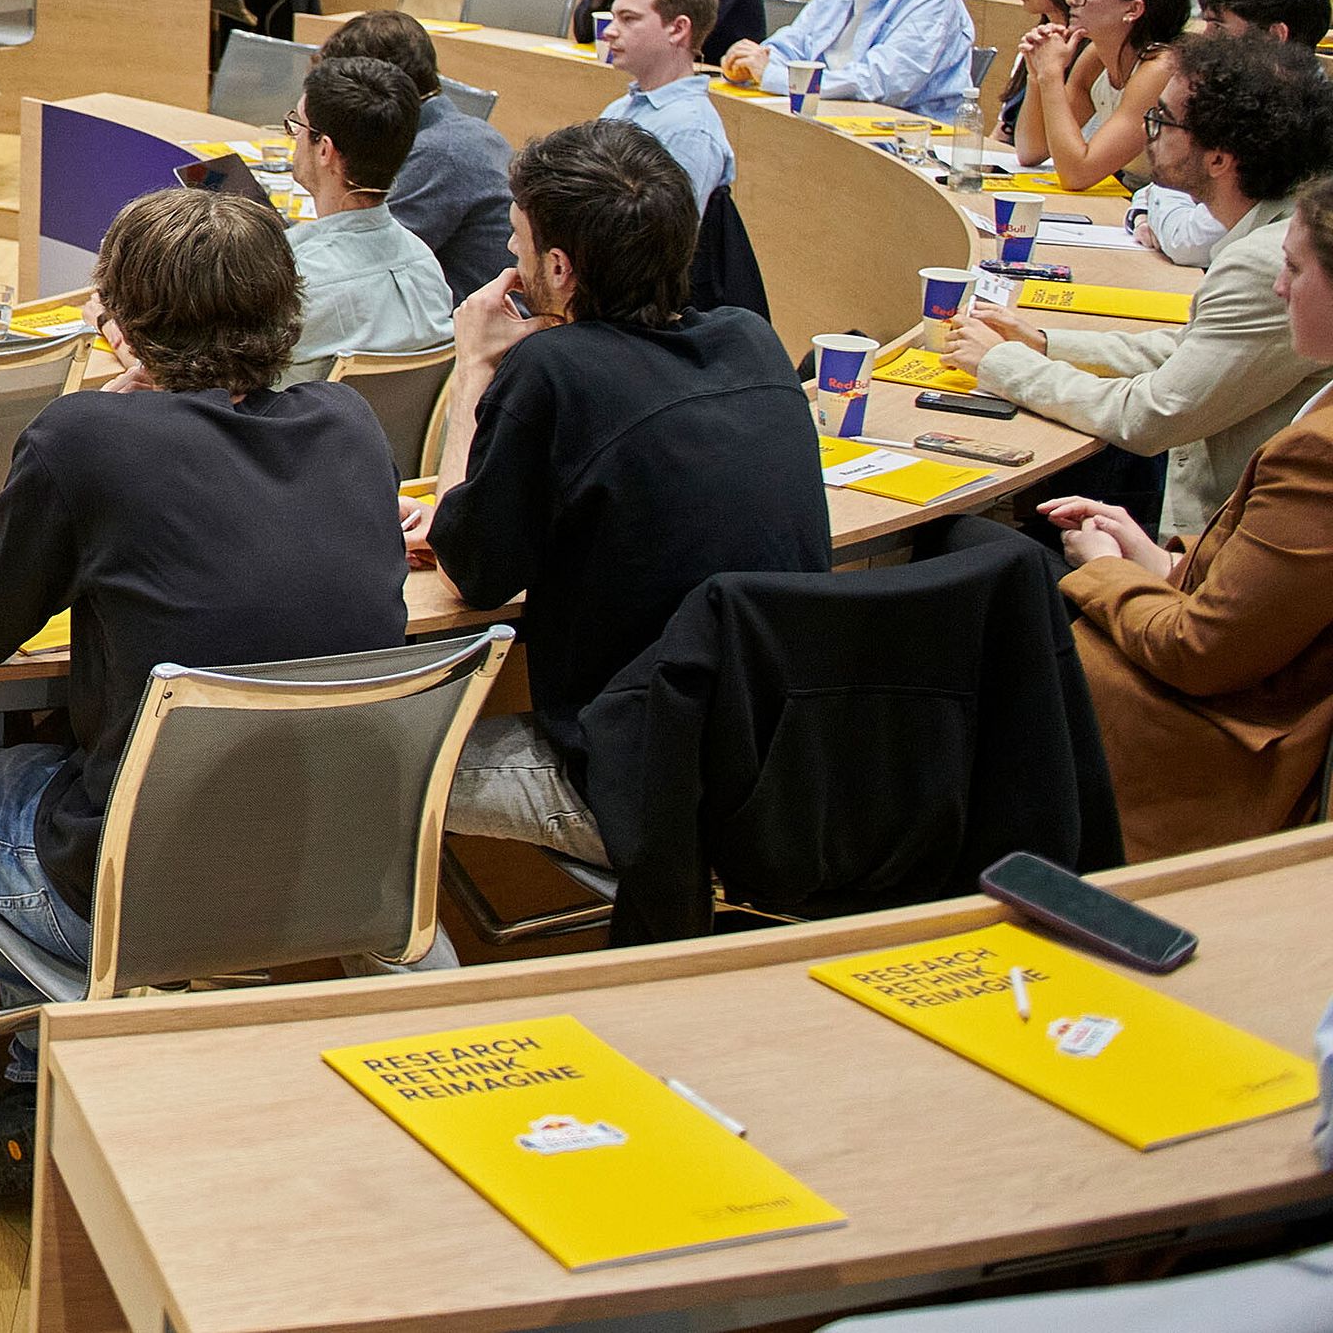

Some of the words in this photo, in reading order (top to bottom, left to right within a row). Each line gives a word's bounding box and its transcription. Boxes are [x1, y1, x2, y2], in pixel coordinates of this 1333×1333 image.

[931, 304, 957, 317] Red
[828, 377, 852, 390] Red
[852, 947, 999, 985] RESEARCH
[874, 965, 997, 997] RETHINK
[362, 1037, 542, 1072] RESEARCH
[379, 1056, 531, 1086] RETHINK
[396, 1065, 585, 1102] REIMAGINE
